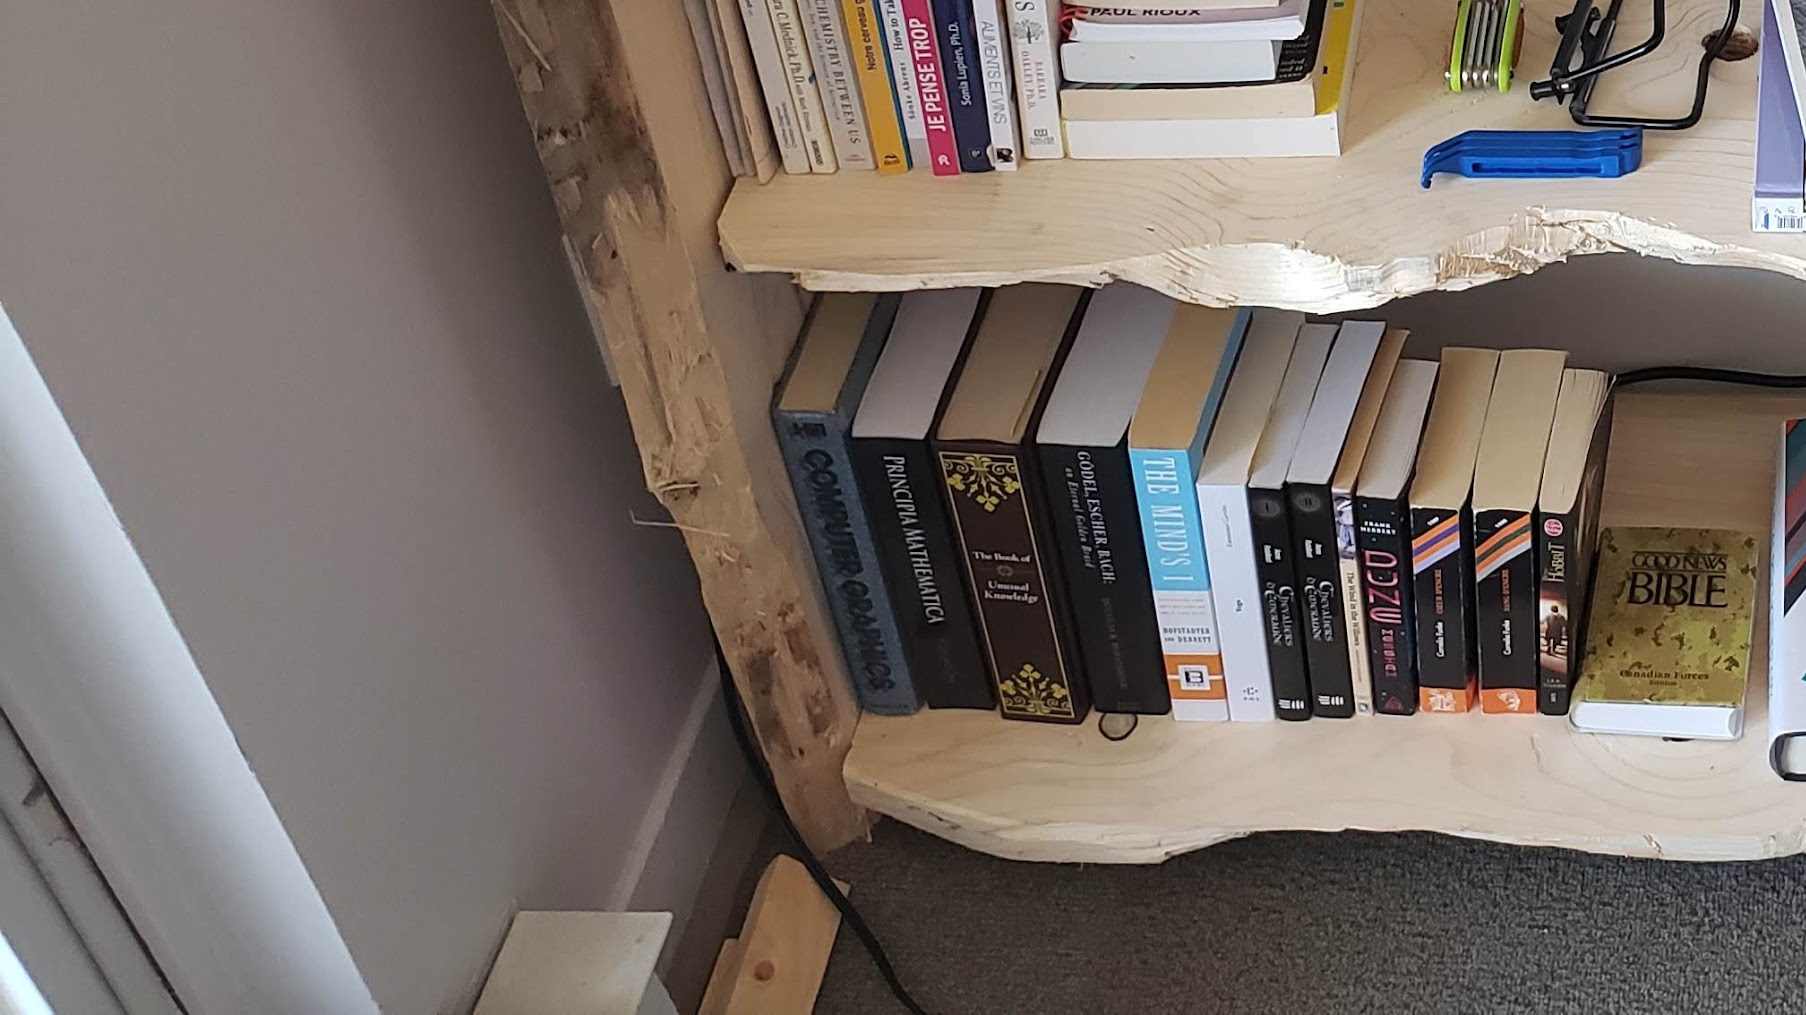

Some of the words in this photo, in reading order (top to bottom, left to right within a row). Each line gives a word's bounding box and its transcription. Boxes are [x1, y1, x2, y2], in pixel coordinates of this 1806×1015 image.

[855, 5, 871, 43] cerveau
[889, 17, 899, 27] to
[1090, 7, 1138, 16] PAUL
[890, 27, 904, 51] How
[906, 15, 933, 60] TROP
[946, 20, 962, 46] Ph.D.
[862, 44, 877, 70] Notre
[975, 19, 1004, 79] ALIMENTS
[950, 45, 970, 80] Lupien,
[916, 61, 945, 114] PENSE
[956, 79, 973, 106] Sonia
[987, 79, 1005, 98] ET
[831, 69, 857, 126] BETWEEN
[846, 126, 861, 145] US
[988, 97, 1009, 125] VINS
[926, 113, 947, 134] JE
[1143, 457, 1180, 494] THE
[1067, 481, 1082, 514] Eternal
[1074, 514, 1088, 543] Golden
[1085, 496, 1109, 548] ESCHER,
[1151, 504, 1192, 566] MIND'S
[883, 455, 918, 526] PRINCIPIA
[903, 524, 945, 625] MATHEMATICA
[972, 551, 992, 560] The
[994, 553, 1019, 562] Book
[1632, 554, 1680, 569] GOOD
[1682, 556, 1728, 571] NEWS
[1346, 572, 1355, 584] The
[1628, 571, 1729, 608] BIBLE
[1347, 585, 1357, 602] Wind
[1349, 602, 1357, 610] in
[1350, 610, 1359, 621] the
[1351, 621, 1362, 646] Willows
[1620, 670, 1671, 679] Canadian
[1674, 671, 1709, 681] Forces
